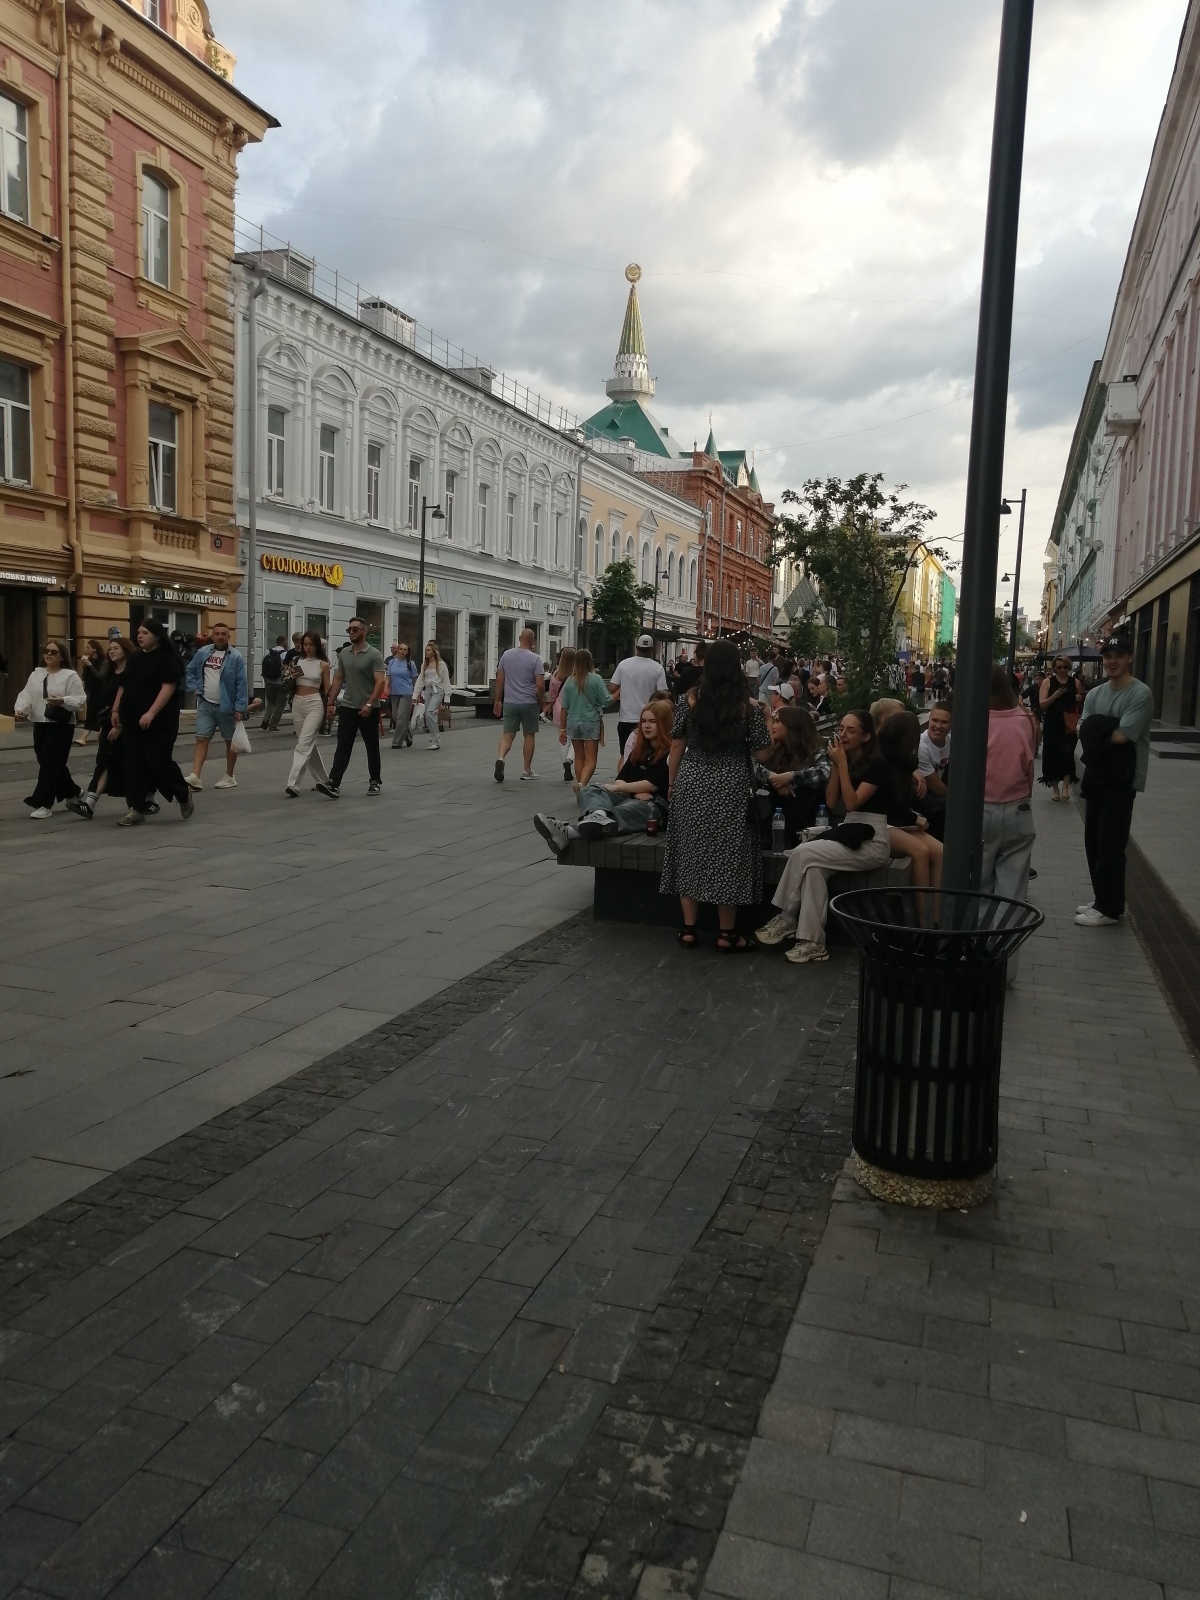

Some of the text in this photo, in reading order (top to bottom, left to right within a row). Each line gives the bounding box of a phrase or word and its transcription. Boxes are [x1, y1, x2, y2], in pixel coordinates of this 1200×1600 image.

[262, 553, 321, 578] СТОЛОВАЯ
[0, 572, 57, 585] лавка камней
[397, 577, 437, 596] КАФЕТРИЙ
[98, 583, 151, 598] DARK SIDE
